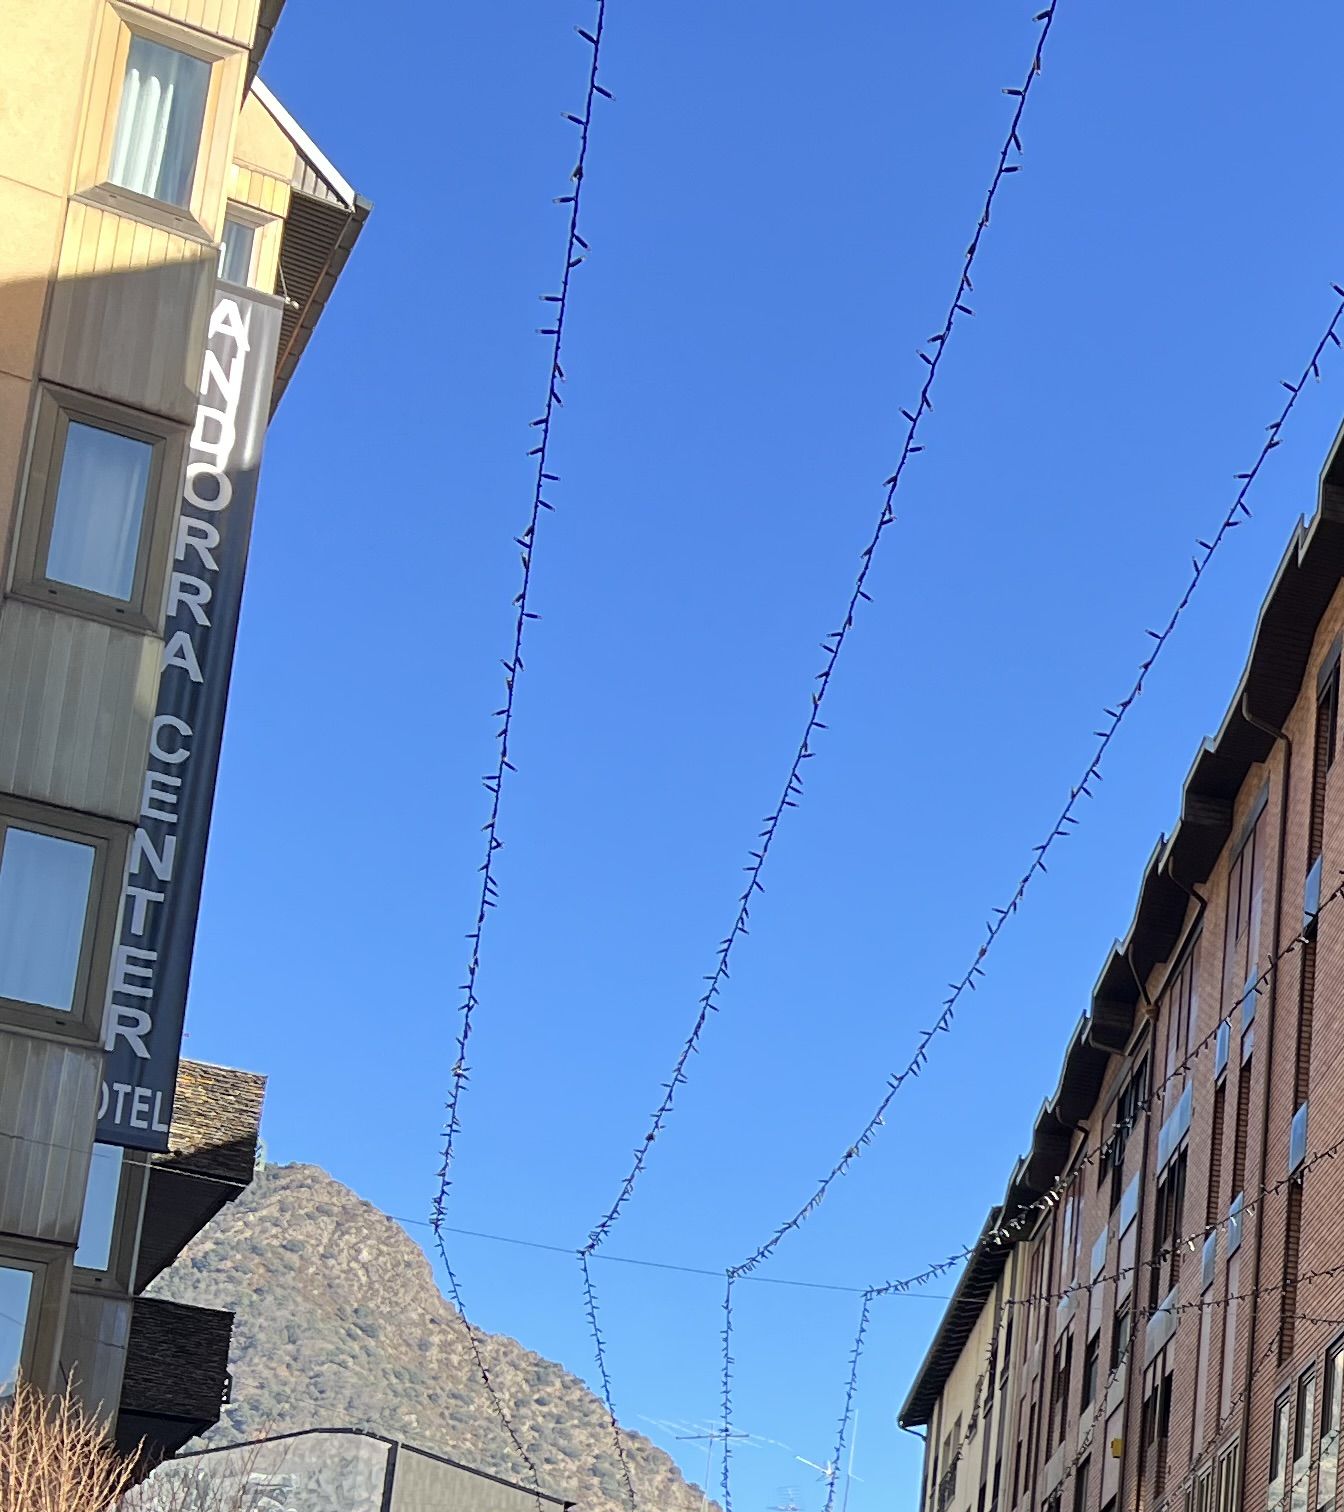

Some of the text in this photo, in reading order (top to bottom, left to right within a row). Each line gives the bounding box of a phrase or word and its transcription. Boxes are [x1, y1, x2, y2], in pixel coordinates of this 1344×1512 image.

[104, 298, 249, 1060] ANDORRA CENTER
[98, 1080, 169, 1133] TEL
